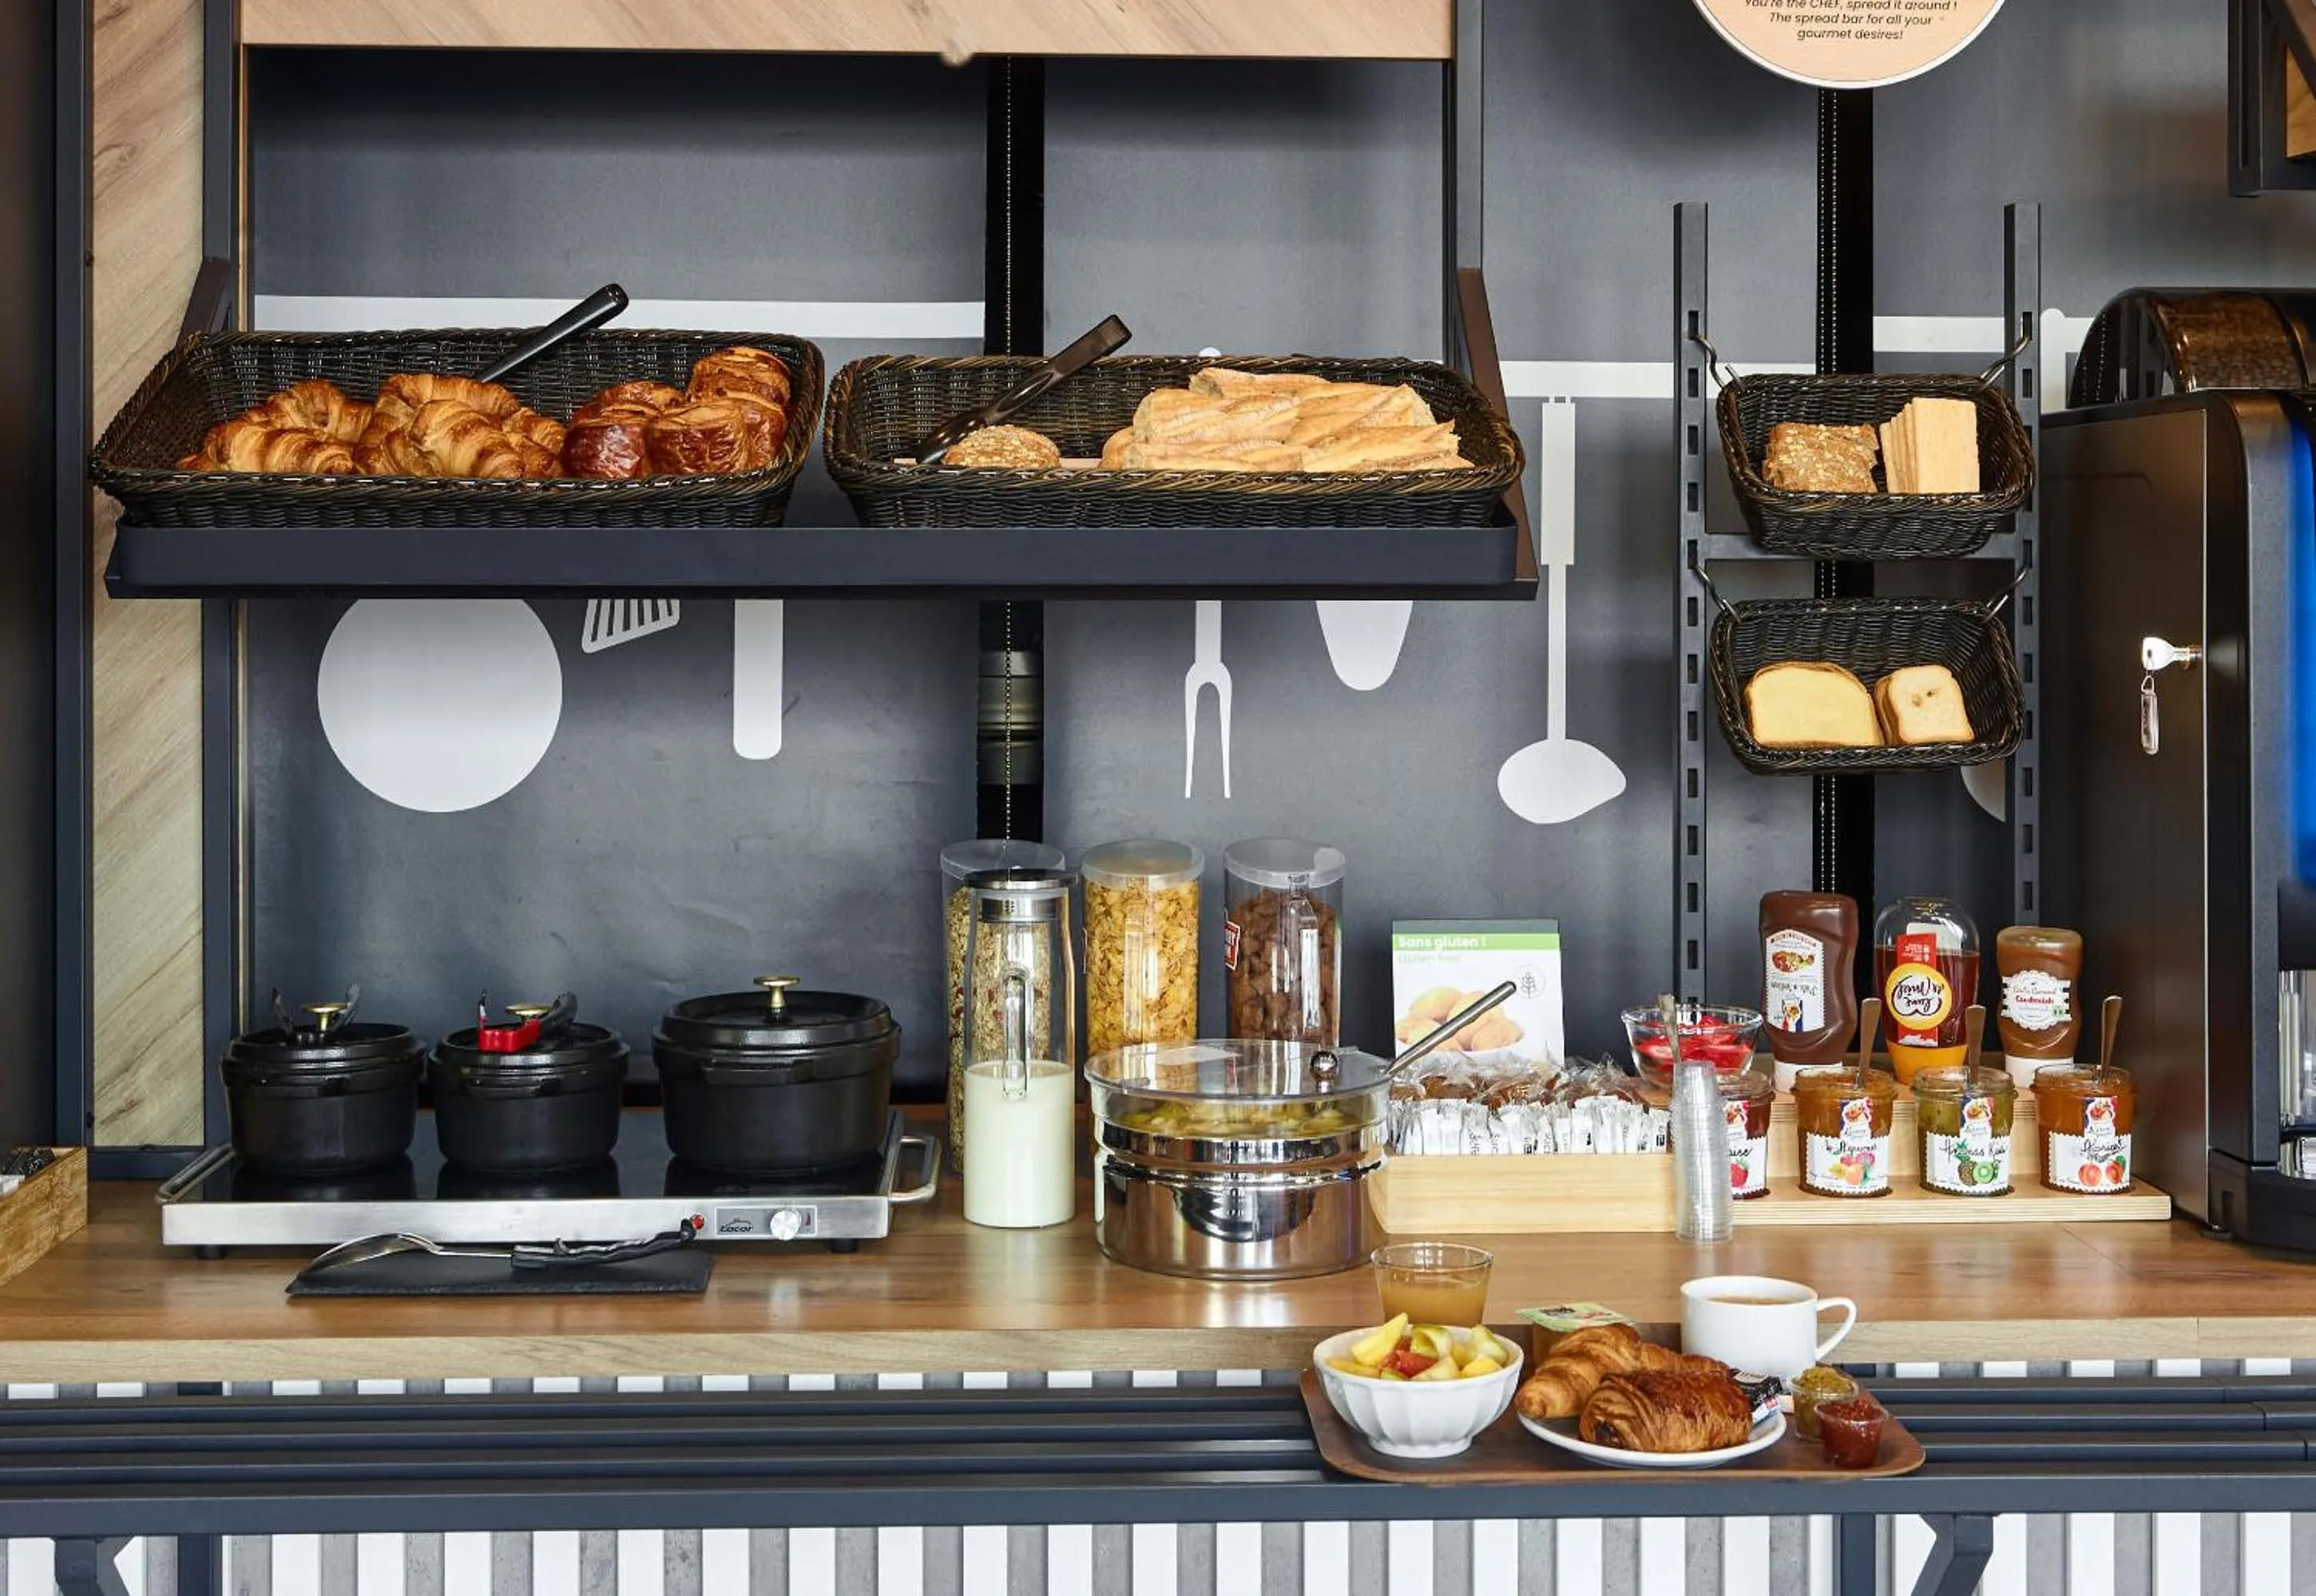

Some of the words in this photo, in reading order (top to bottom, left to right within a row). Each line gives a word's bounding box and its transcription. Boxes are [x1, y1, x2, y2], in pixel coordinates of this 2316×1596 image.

[1810, 0, 1843, 10] CHEF,
[1846, 0, 1890, 11] spread
[1894, 0, 1902, 10] it
[1905, 0, 1951, 10] around
[1770, 12, 1791, 22] The
[1795, 13, 1840, 26] spread
[1842, 14, 1864, 24] bar
[1866, 14, 1884, 25] for
[1886, 14, 1902, 25] all
[1904, 16, 1932, 28] your
[1797, 29, 1852, 41] gourmet
[1854, 29, 1904, 39] desires!
[1398, 937, 1432, 948] Sans
[1434, 935, 1479, 951] gluten
